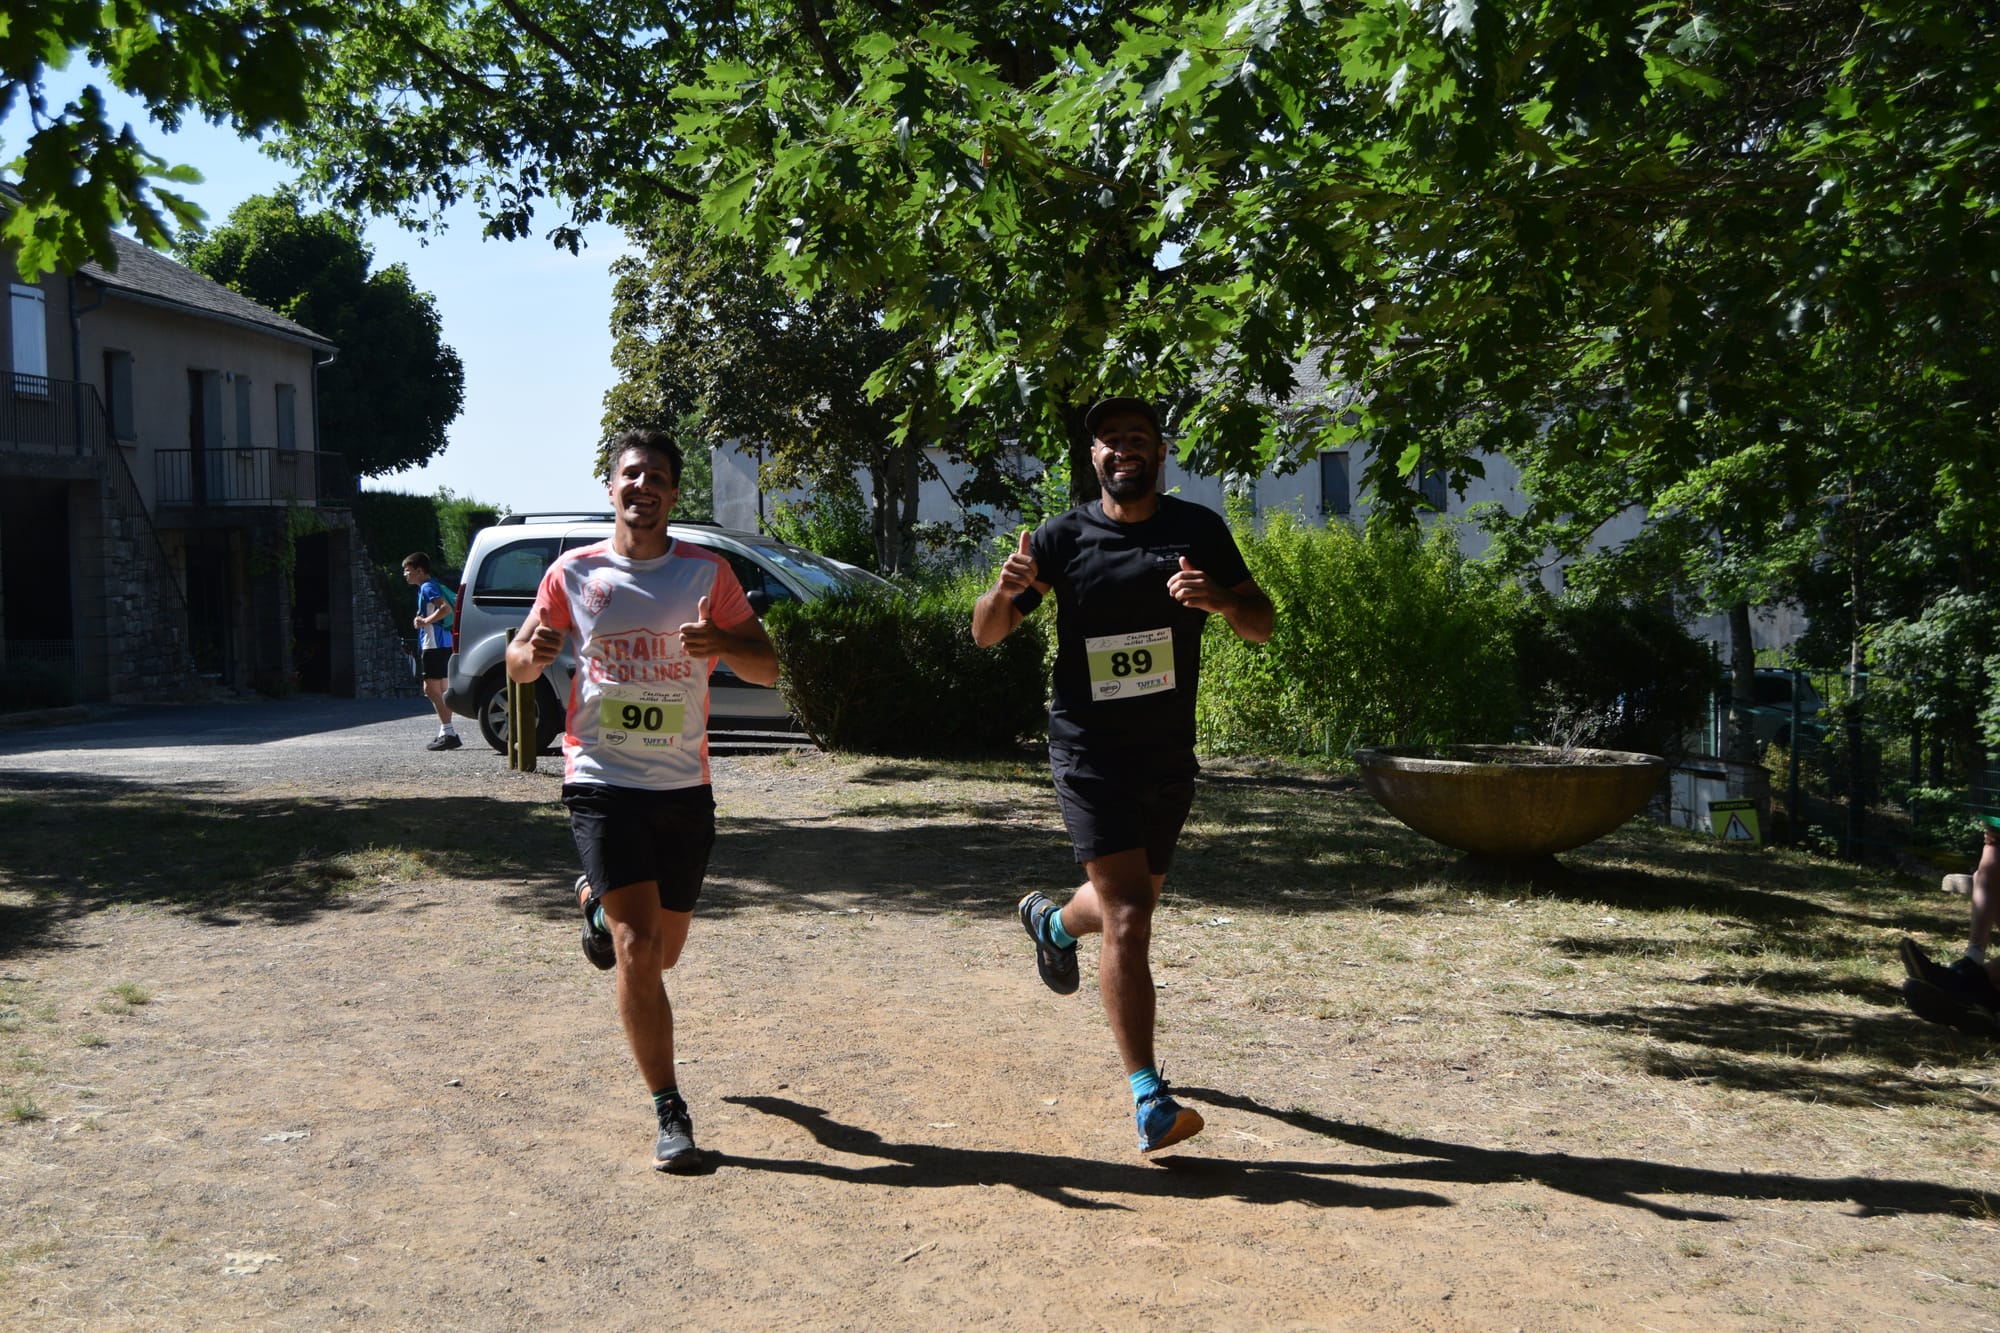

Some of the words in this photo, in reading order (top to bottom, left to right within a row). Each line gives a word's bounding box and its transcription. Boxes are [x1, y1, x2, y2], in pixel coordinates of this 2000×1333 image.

[600, 636, 674, 662] TRAIL
[605, 660, 692, 682] COLLINES
[1111, 649, 1152, 677] 89
[622, 705, 663, 731] 90
